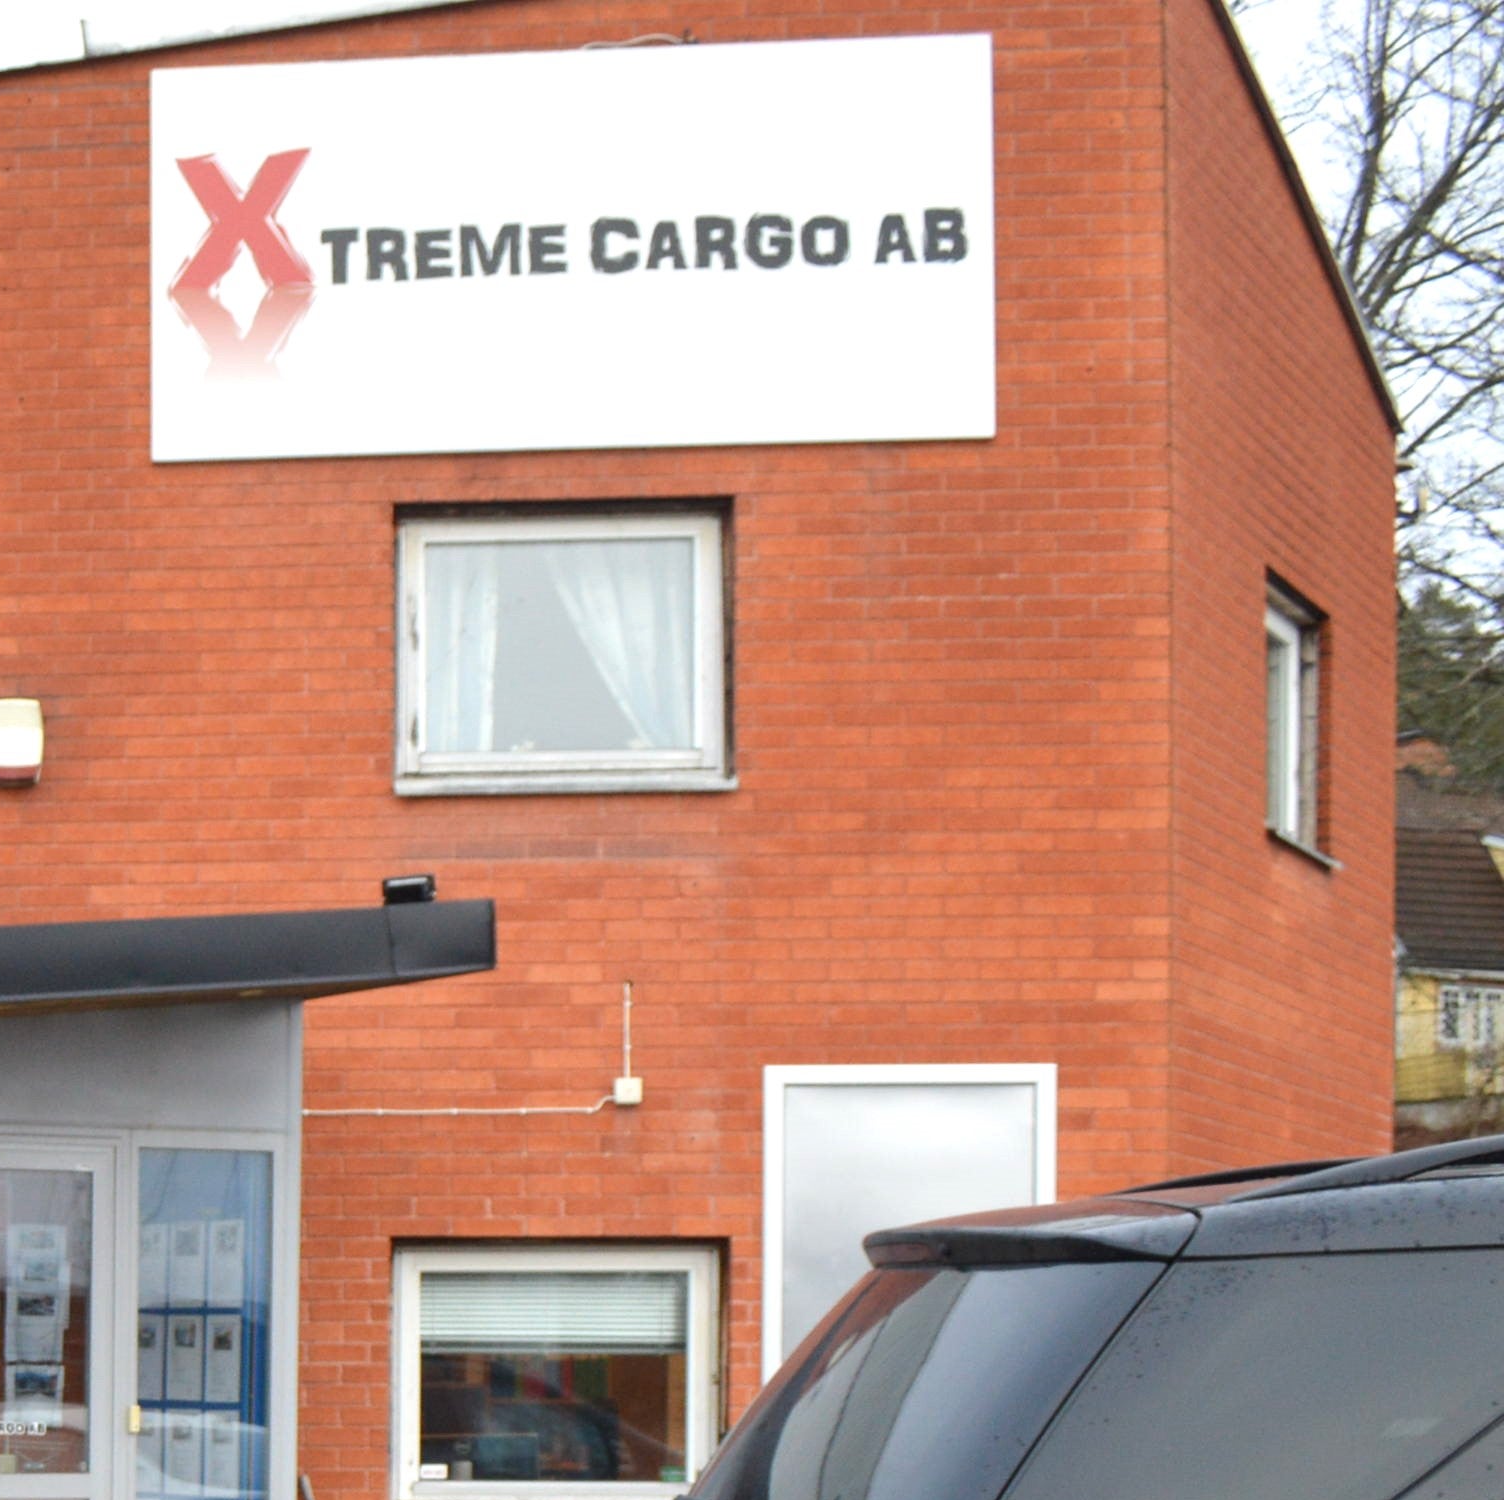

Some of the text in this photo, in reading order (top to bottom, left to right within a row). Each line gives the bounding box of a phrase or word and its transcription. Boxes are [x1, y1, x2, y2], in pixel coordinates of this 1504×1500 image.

[590, 214, 851, 274] CARGO
[874, 207, 969, 264] AB
[26, 1421, 47, 1435] AB
